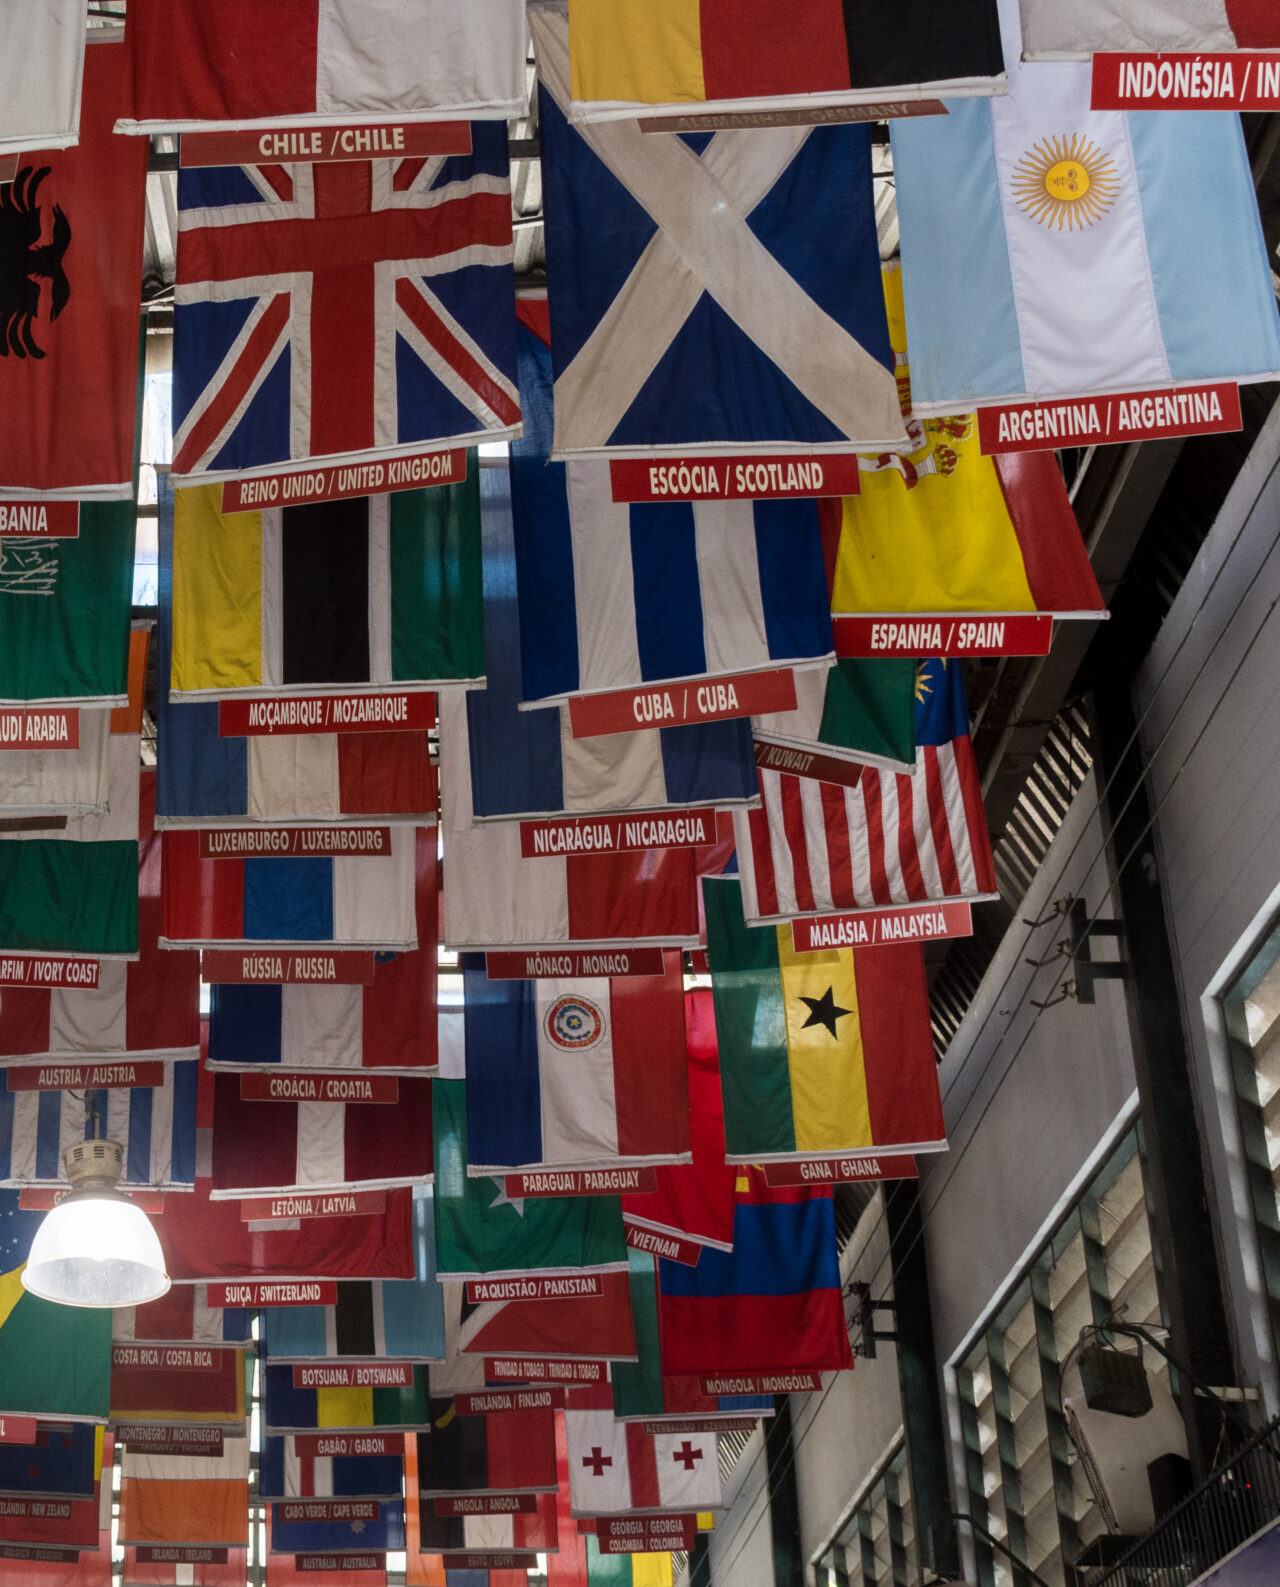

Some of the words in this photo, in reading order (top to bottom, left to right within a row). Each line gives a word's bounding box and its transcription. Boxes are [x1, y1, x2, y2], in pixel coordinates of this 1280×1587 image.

[1119, 57, 1234, 98] INDONÉSIA
[259, 133, 322, 156] CHILE
[999, 404, 1100, 442] ARGENTINA
[1119, 391, 1222, 433] ARGENTINA
[240, 479, 278, 504] REINO
[283, 473, 324, 498] UNIDO
[339, 465, 384, 491] UNITED
[388, 455, 452, 485] KINGDOM
[650, 462, 720, 494] ESCÓCIA
[736, 463, 823, 492] SCOTLAND
[871, 624, 941, 649] ESPANHA
[958, 623, 1004, 648] SPAIN
[634, 693, 674, 722] CUBA
[697, 684, 738, 713] CUBA
[249, 701, 322, 732] MOÇAMBIQUE
[334, 697, 407, 722] MOZAMBIQUE
[26, 716, 67, 740] ARABIA
[766, 748, 814, 771] KUWAIT
[209, 831, 289, 851] LUXEMBURGO
[302, 831, 382, 849] LUXEMBOURG
[533, 819, 611, 853] NICARÁGUA
[625, 818, 705, 846] NICARAGUA
[882, 913, 947, 939] MALAYSIA
[34, 962, 64, 981] IVORY
[66, 963, 97, 984] COAST
[242, 953, 283, 978] RÚSSIA
[296, 958, 335, 979] RUSSIA
[583, 955, 629, 973] MONACO
[269, 1076, 316, 1098] CROÁCIA
[327, 1080, 372, 1098] CROATIA
[800, 1163, 832, 1179] GANA
[841, 1159, 881, 1176] GHANA
[523, 1174, 574, 1191] PARAGUAI
[585, 1171, 638, 1189] PARAGUAY
[322, 1196, 356, 1213] LATVIA
[632, 1231, 679, 1258] VIETNAM
[226, 1286, 251, 1306] SUIÇA
[260, 1285, 320, 1301] SWITZERLAND
[114, 1349, 138, 1365] COSTA
[141, 1350, 158, 1364] RICA
[167, 1351, 191, 1365] COSTA
[194, 1352, 212, 1366] RICA
[302, 1369, 348, 1384] BOTSUANA
[357, 1368, 405, 1384] BOTSWANA
[706, 1380, 754, 1394] MONGOLA
[518, 1392, 551, 1407] FINLAND
[119, 1427, 166, 1441] MONTENEGRO
[173, 1428, 220, 1442] MONTENEGRO
[318, 1437, 346, 1454] GABÃO
[355, 1439, 384, 1453] GABON
[285, 1506, 303, 1518] CABO
[305, 1505, 326, 1517] VERDE
[333, 1505, 350, 1517] CAPE
[351, 1504, 373, 1516] VERDE
[454, 1499, 483, 1511] ANGOLA
[490, 1498, 519, 1510] ANGOLA
[650, 1519, 683, 1534] GEORGIA
[650, 1536, 684, 1550] COLOMBIA
[343, 1558, 376, 1568] AUSTRALIA
